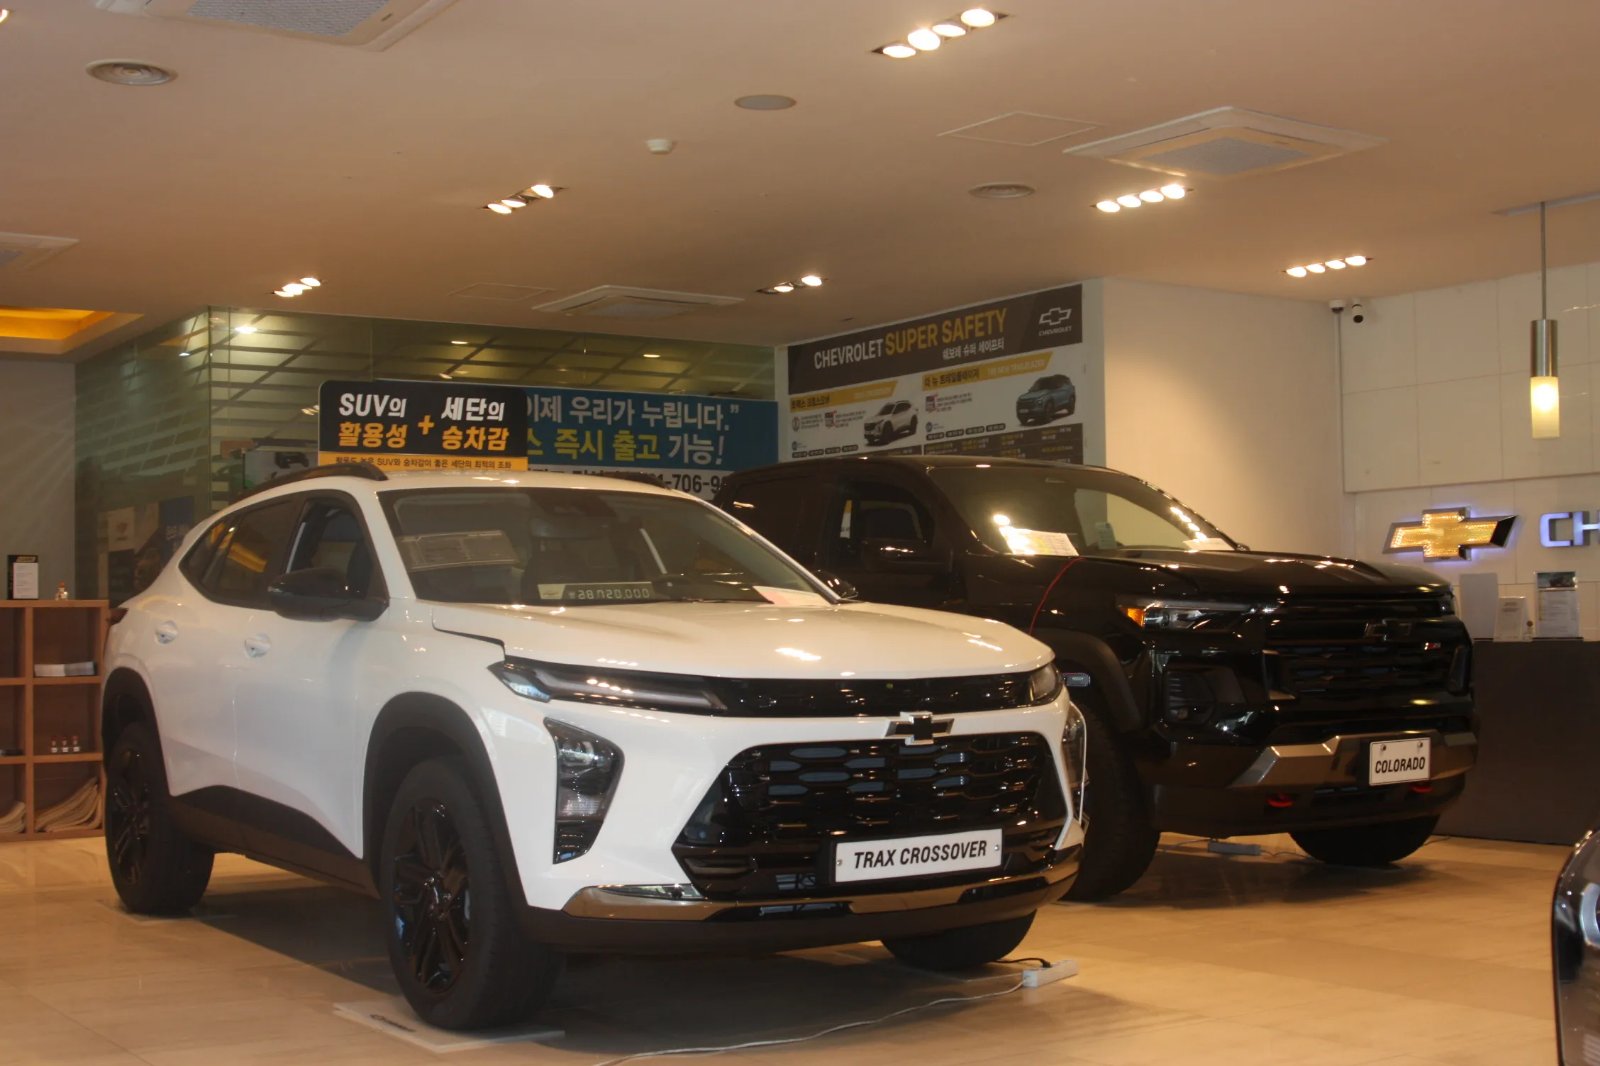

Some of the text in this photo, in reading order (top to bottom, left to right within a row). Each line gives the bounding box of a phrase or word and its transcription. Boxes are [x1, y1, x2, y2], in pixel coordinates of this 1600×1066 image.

[814, 308, 1007, 370] CHEVROLET SUPER SAFETY
[338, 393, 407, 418] SUV의
[441, 397, 506, 421] 세단의
[569, 396, 635, 426] 우리가
[338, 421, 408, 449] 활용성
[442, 425, 510, 451] 승차감
[554, 428, 604, 461] 즉시
[612, 430, 661, 462] 출고
[668, 434, 724, 465] 가능!
[1375, 756, 1426, 774] COLORADO
[854, 840, 987, 869] TRAX CROSSOVER
